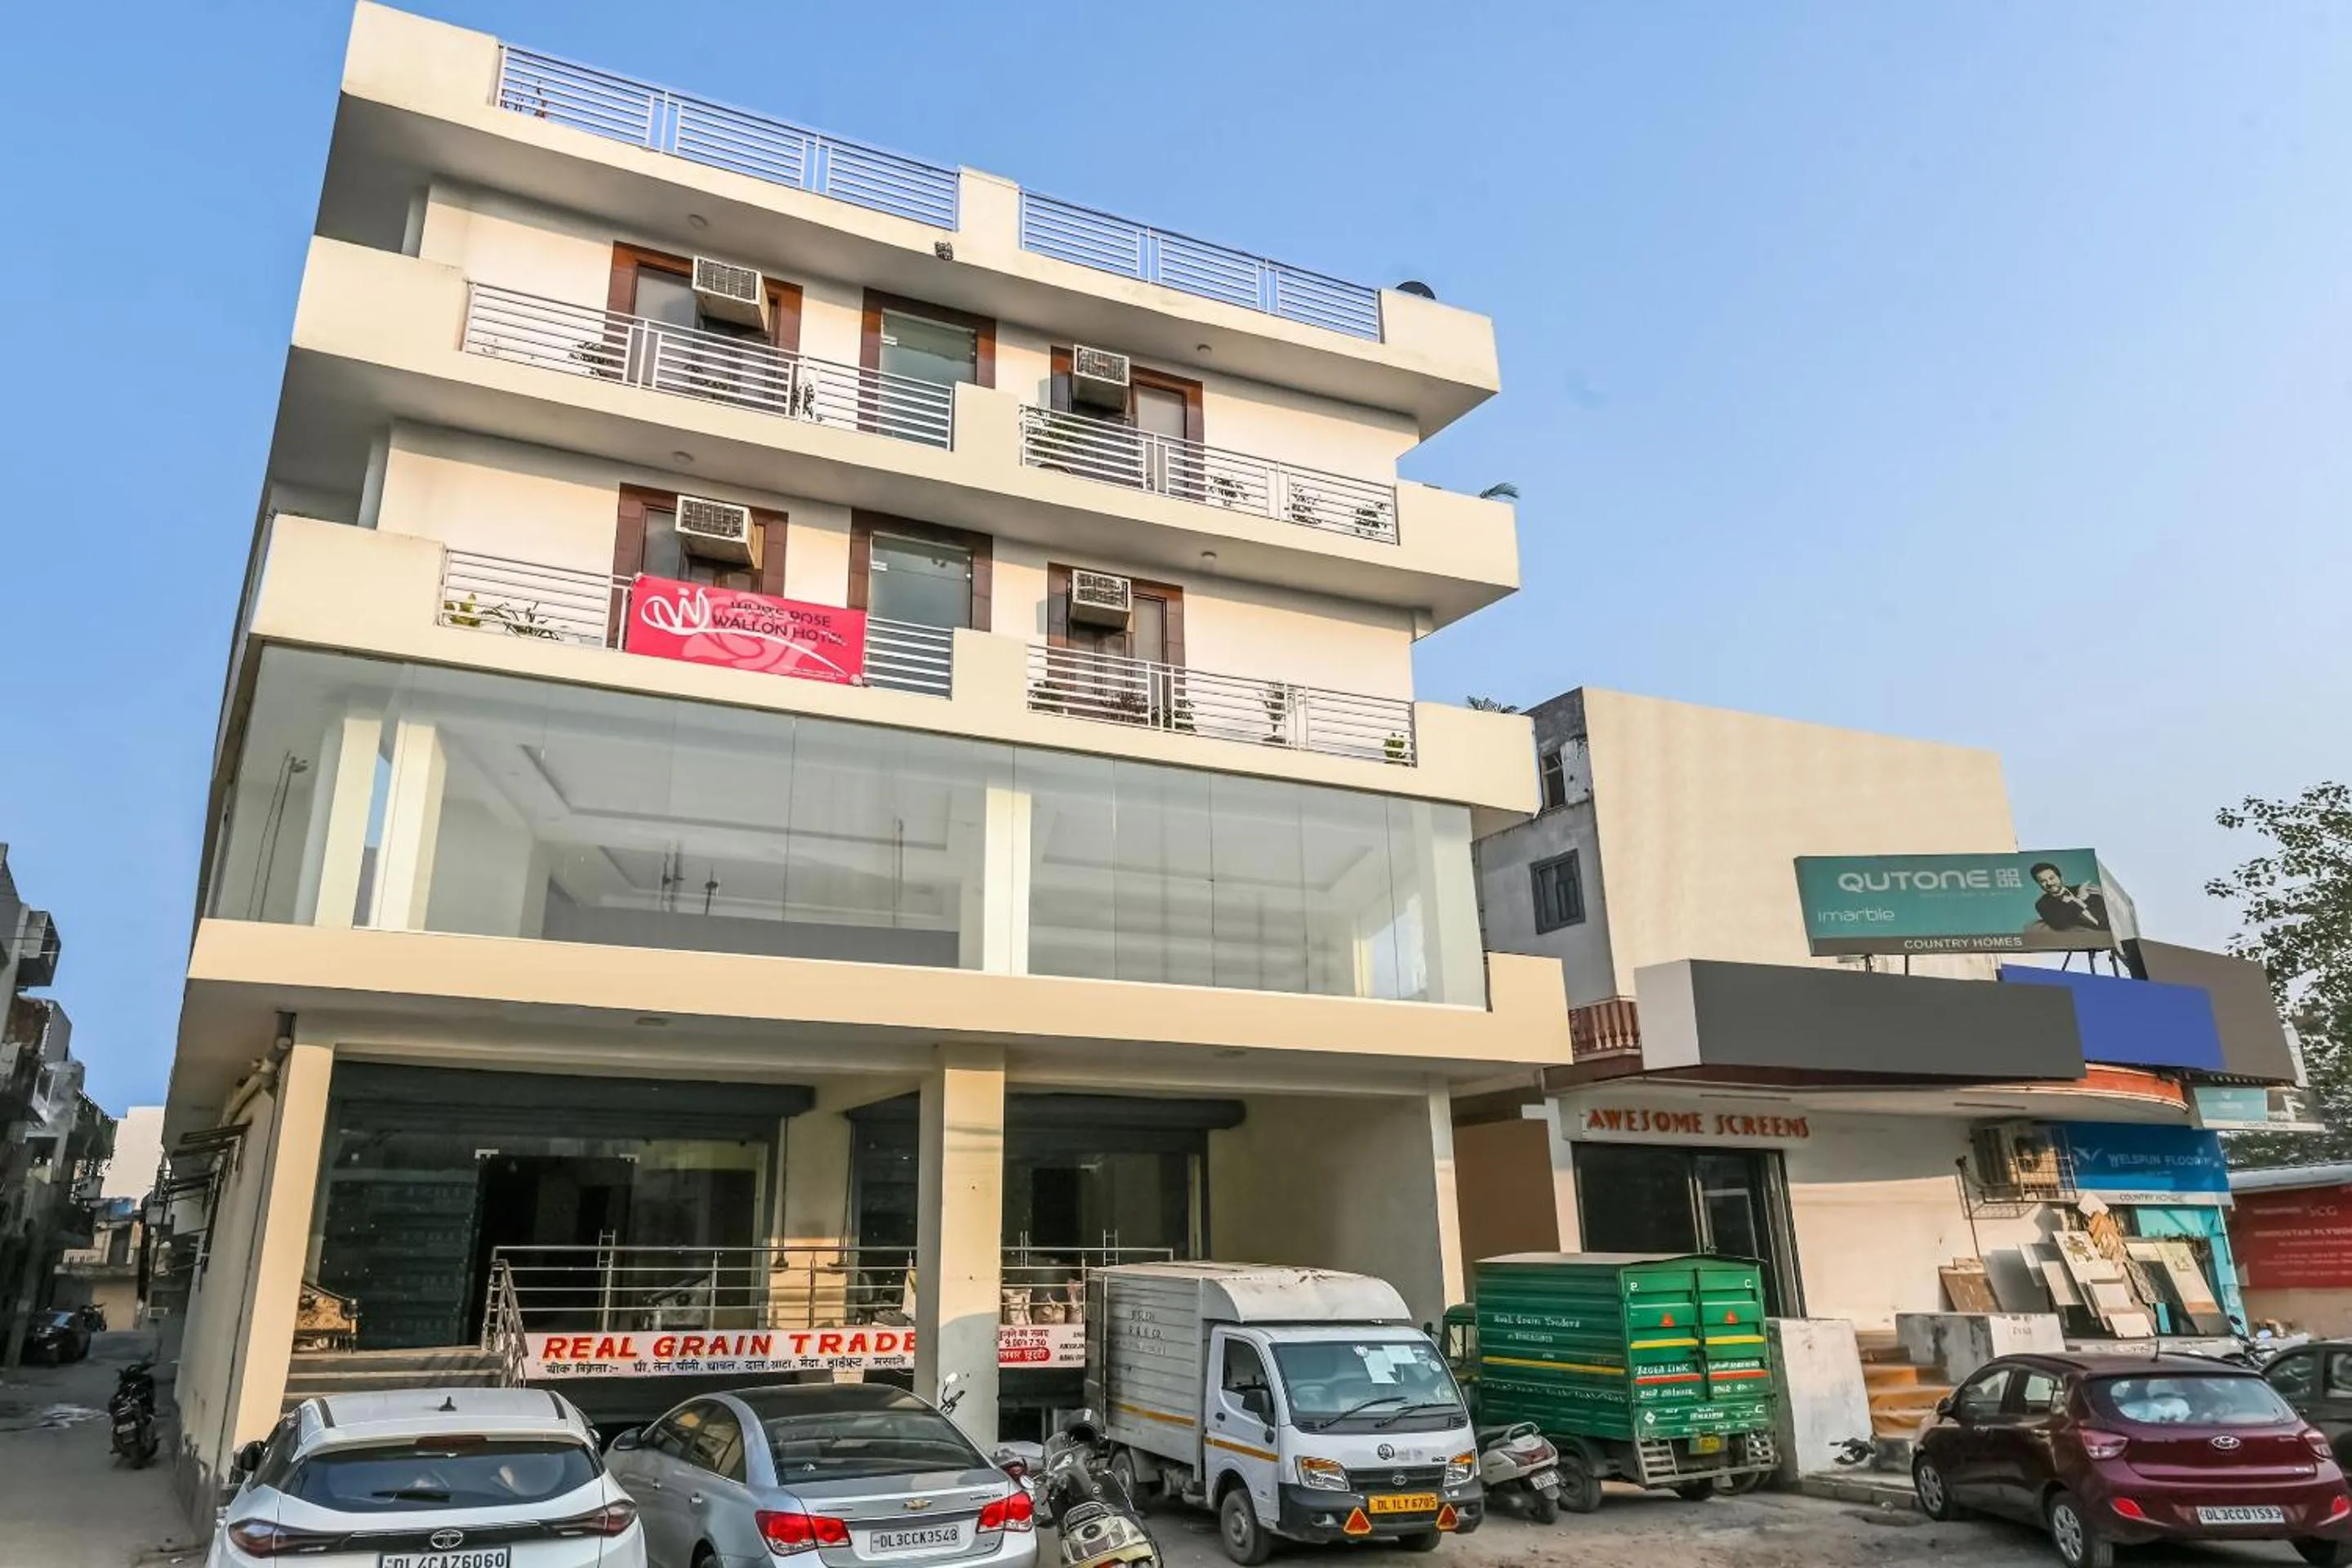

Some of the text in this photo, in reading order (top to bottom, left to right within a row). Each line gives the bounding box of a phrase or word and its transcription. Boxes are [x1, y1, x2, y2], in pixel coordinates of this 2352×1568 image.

[792, 627, 844, 646] HOTEL
[1838, 869, 1991, 893] QUTONE
[1904, 937, 2023, 950] COUNTRY HOMES
[1586, 1108, 1811, 1138] AWESOME SCREENS
[542, 1336, 638, 1358] REAL
[653, 1334, 772, 1358] GRAIN
